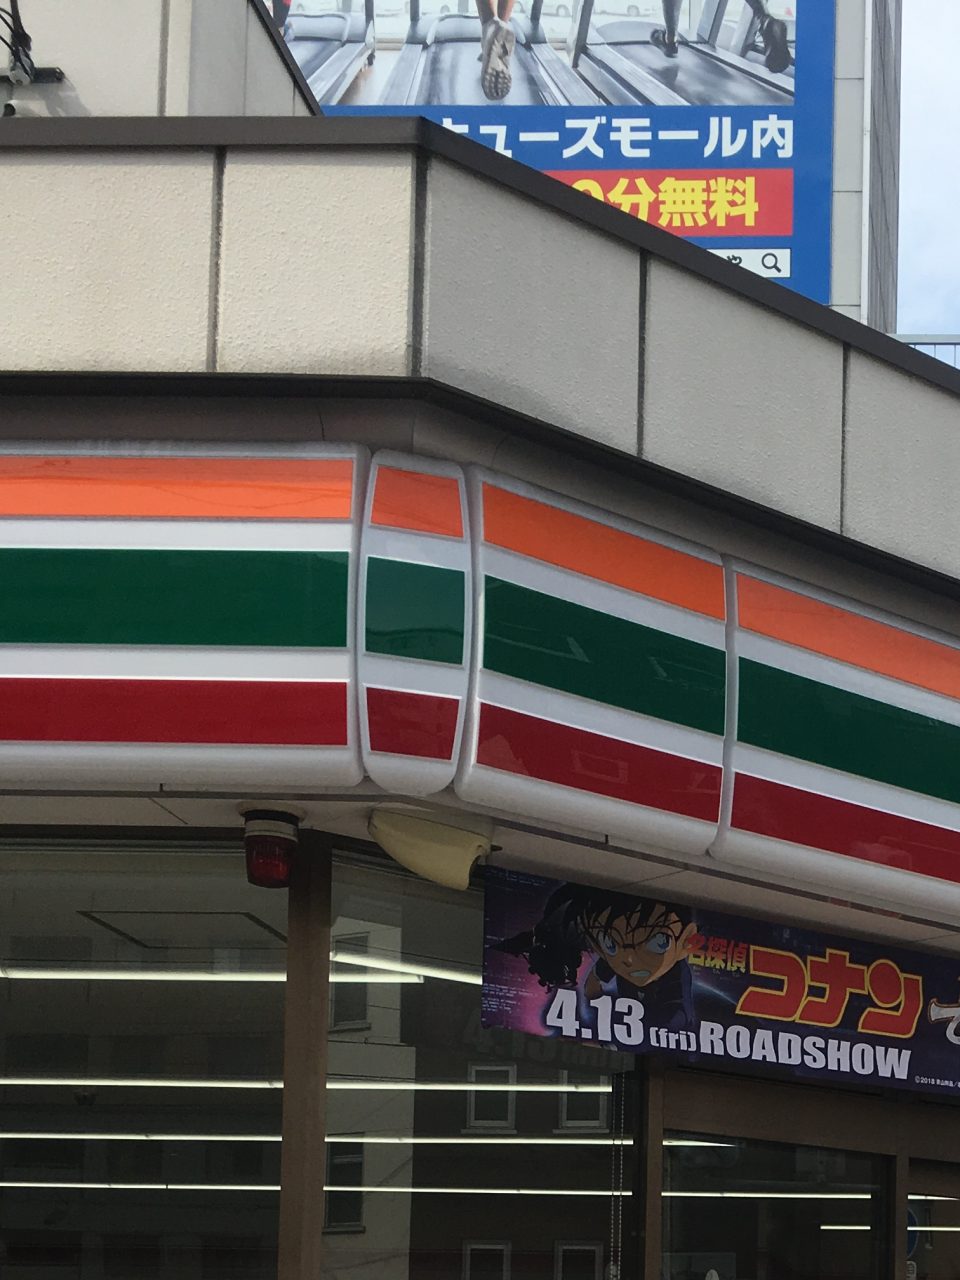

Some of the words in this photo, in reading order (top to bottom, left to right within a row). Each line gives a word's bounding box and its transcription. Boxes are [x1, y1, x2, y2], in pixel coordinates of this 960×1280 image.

[546, 987, 645, 1046] 4.13
[699, 1021, 912, 1081] ROADSHOW
[686, 933, 747, 974] 名探偵
[735, 945, 926, 1039] コナン
